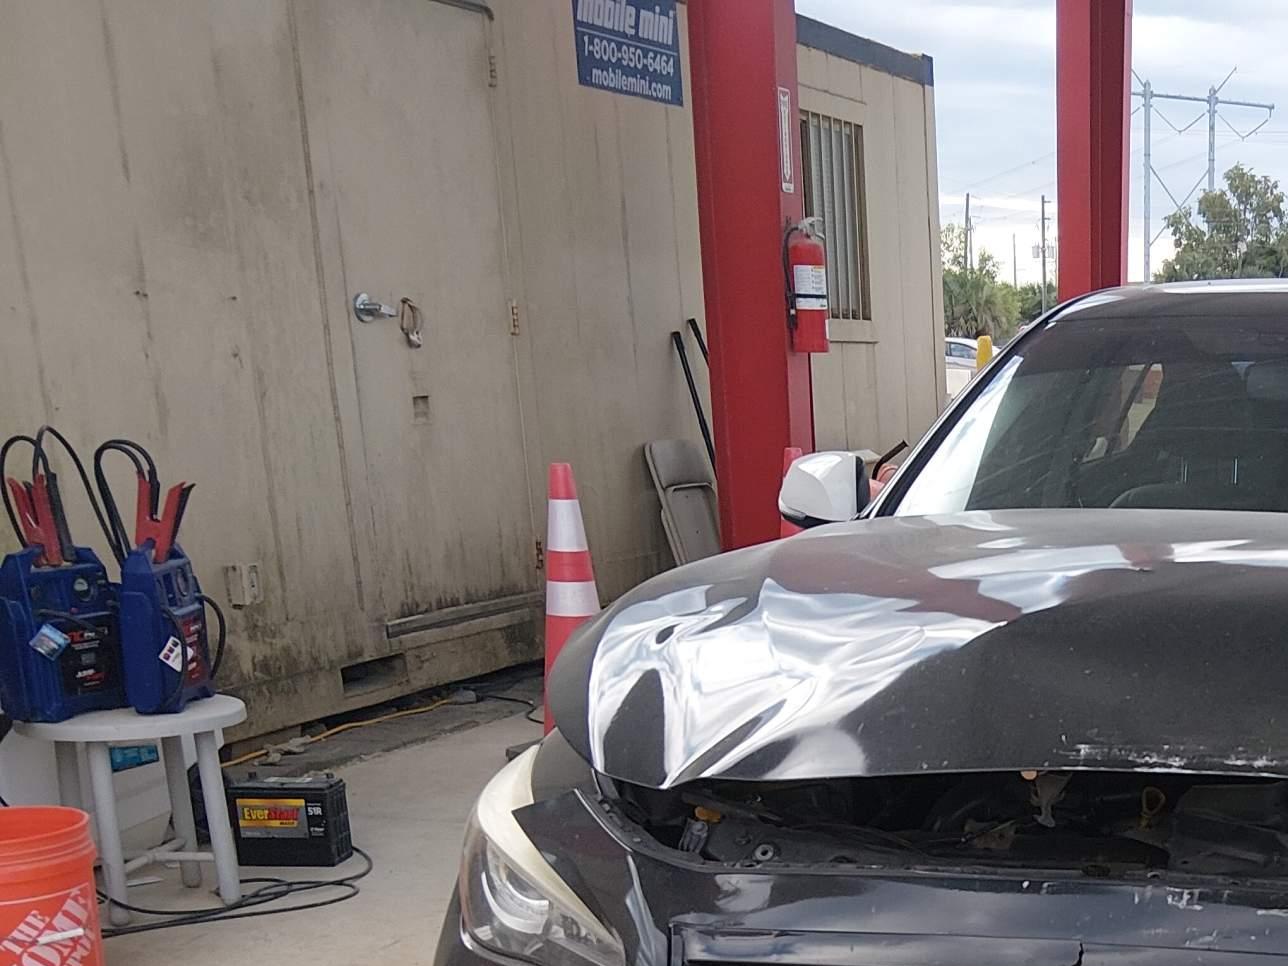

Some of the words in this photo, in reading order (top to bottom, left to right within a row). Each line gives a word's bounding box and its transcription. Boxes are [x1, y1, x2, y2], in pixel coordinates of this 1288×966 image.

[576, 0, 636, 37] mobile
[638, 5, 674, 45] mini
[583, 35, 674, 77] 1-800-950-6464
[592, 67, 672, 100] mobilemini.com
[0, 910, 50, 957] THE
